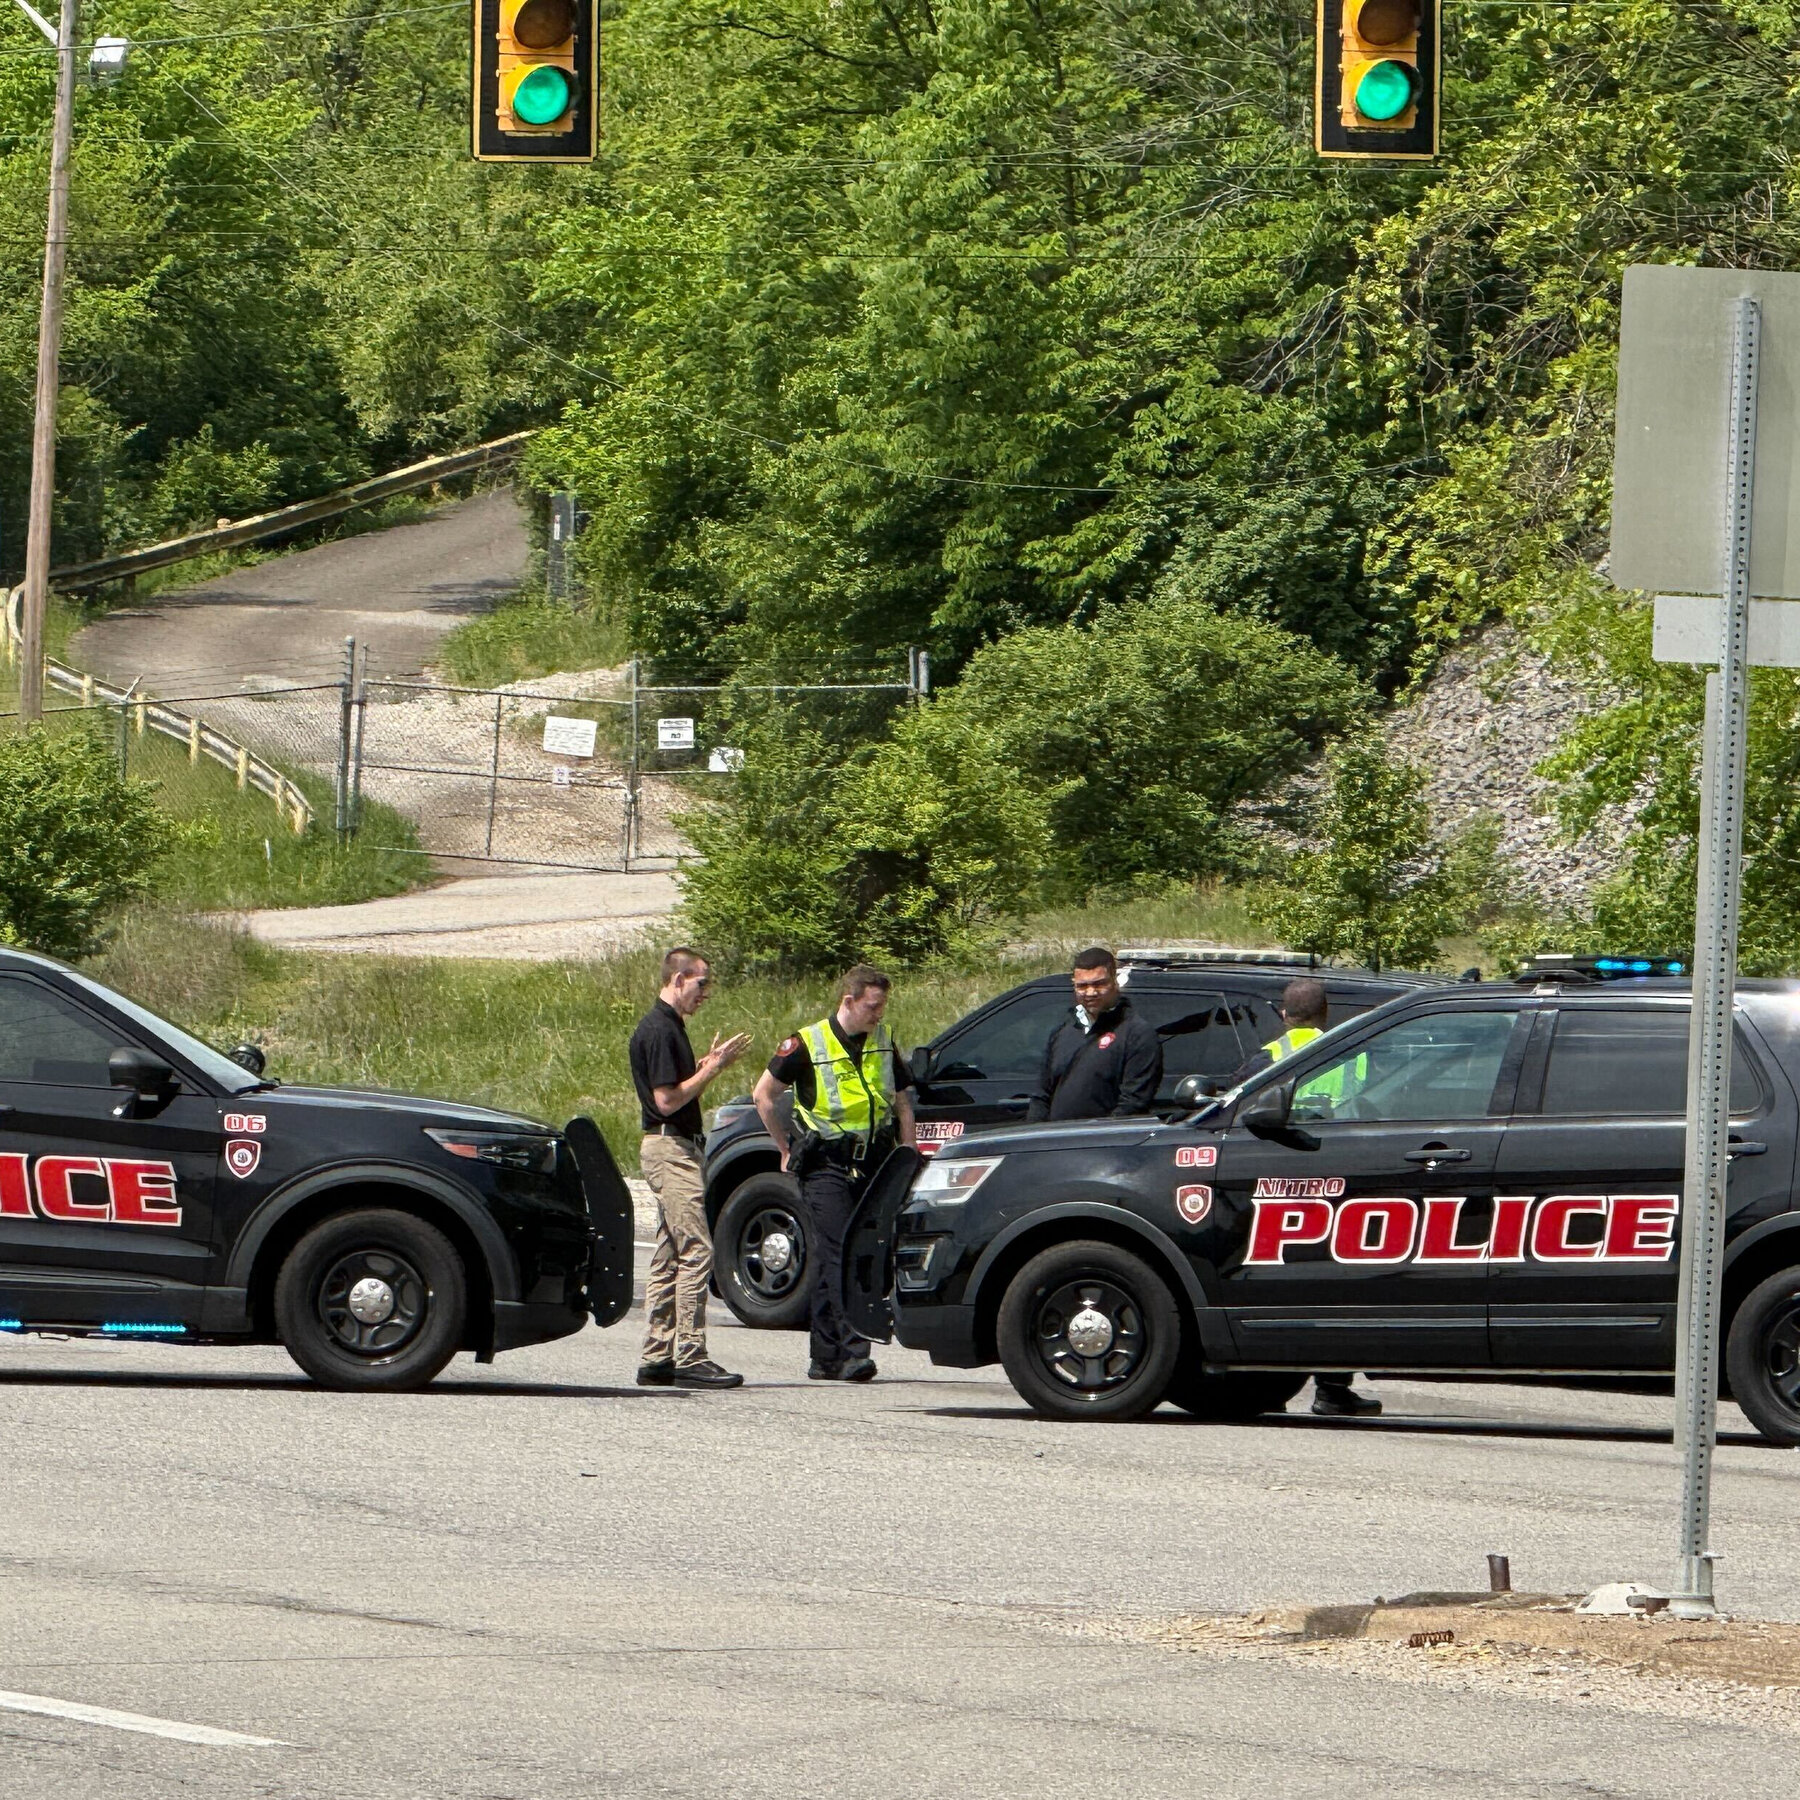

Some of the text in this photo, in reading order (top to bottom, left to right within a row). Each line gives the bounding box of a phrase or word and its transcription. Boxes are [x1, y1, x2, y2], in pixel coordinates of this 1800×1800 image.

[224, 1113, 267, 1133] 06
[1175, 1146, 1217, 1167] 09
[0, 1152, 182, 1227] ICE
[1253, 1177, 1346, 1197] NITRO
[1243, 1195, 1679, 1265] POLICE
